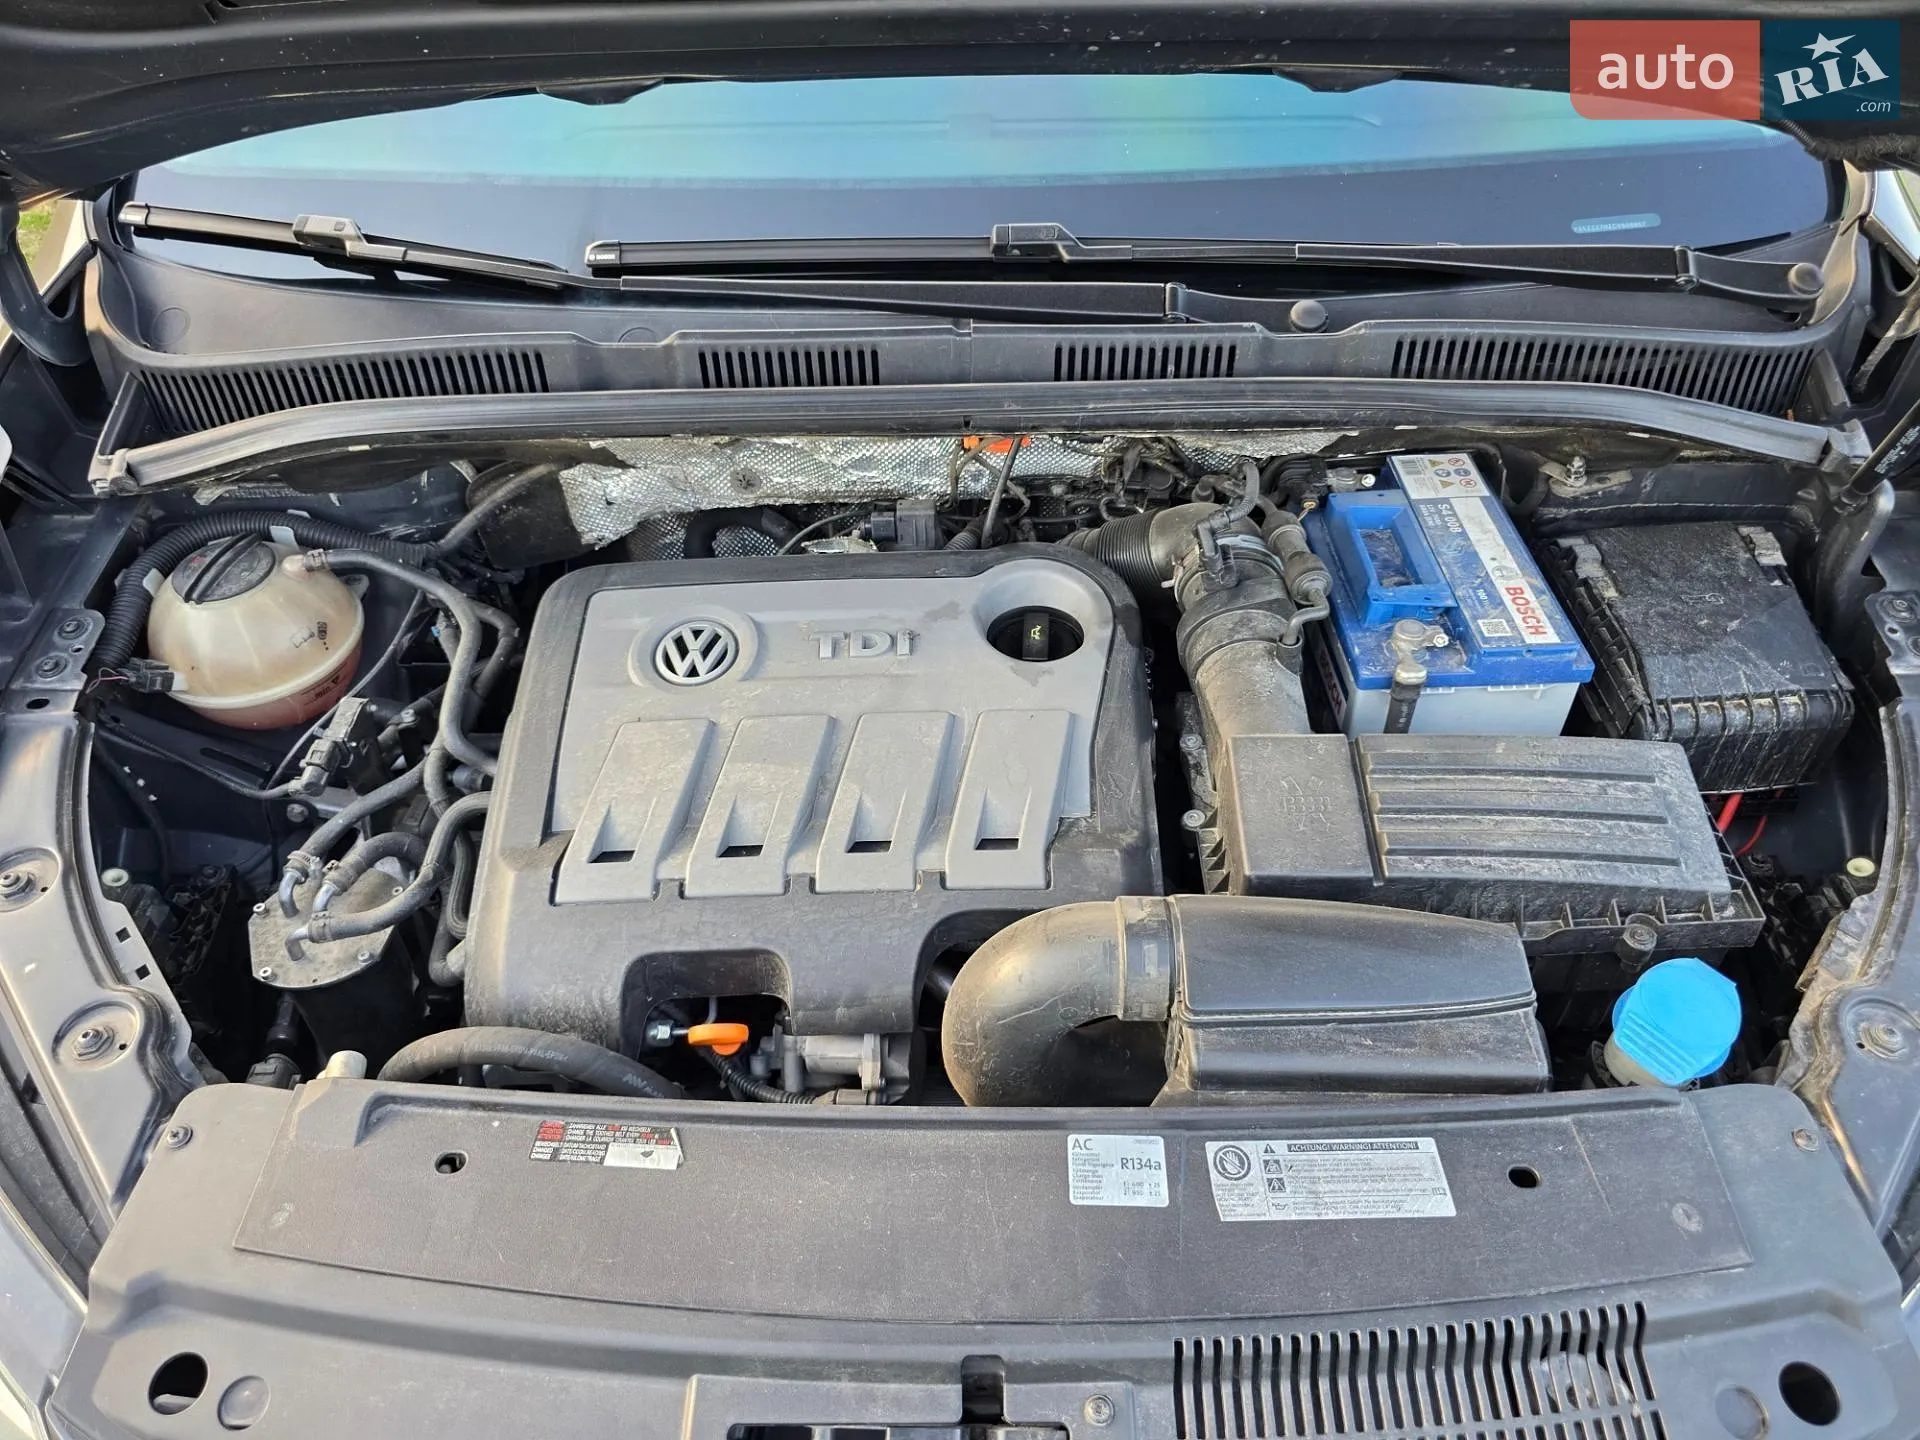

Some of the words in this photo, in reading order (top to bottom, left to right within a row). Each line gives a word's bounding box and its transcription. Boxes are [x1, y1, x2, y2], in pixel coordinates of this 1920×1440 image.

[1504, 586, 1548, 636] BOSCH
[810, 631, 915, 659] TDI
[1071, 1138, 1094, 1151] AC
[1290, 1143, 1331, 1152] ACHTUNG!
[1332, 1143, 1371, 1151] WARNING!
[1372, 1142, 1417, 1150] ATTENTION!
[1120, 1157, 1162, 1171] R134a
